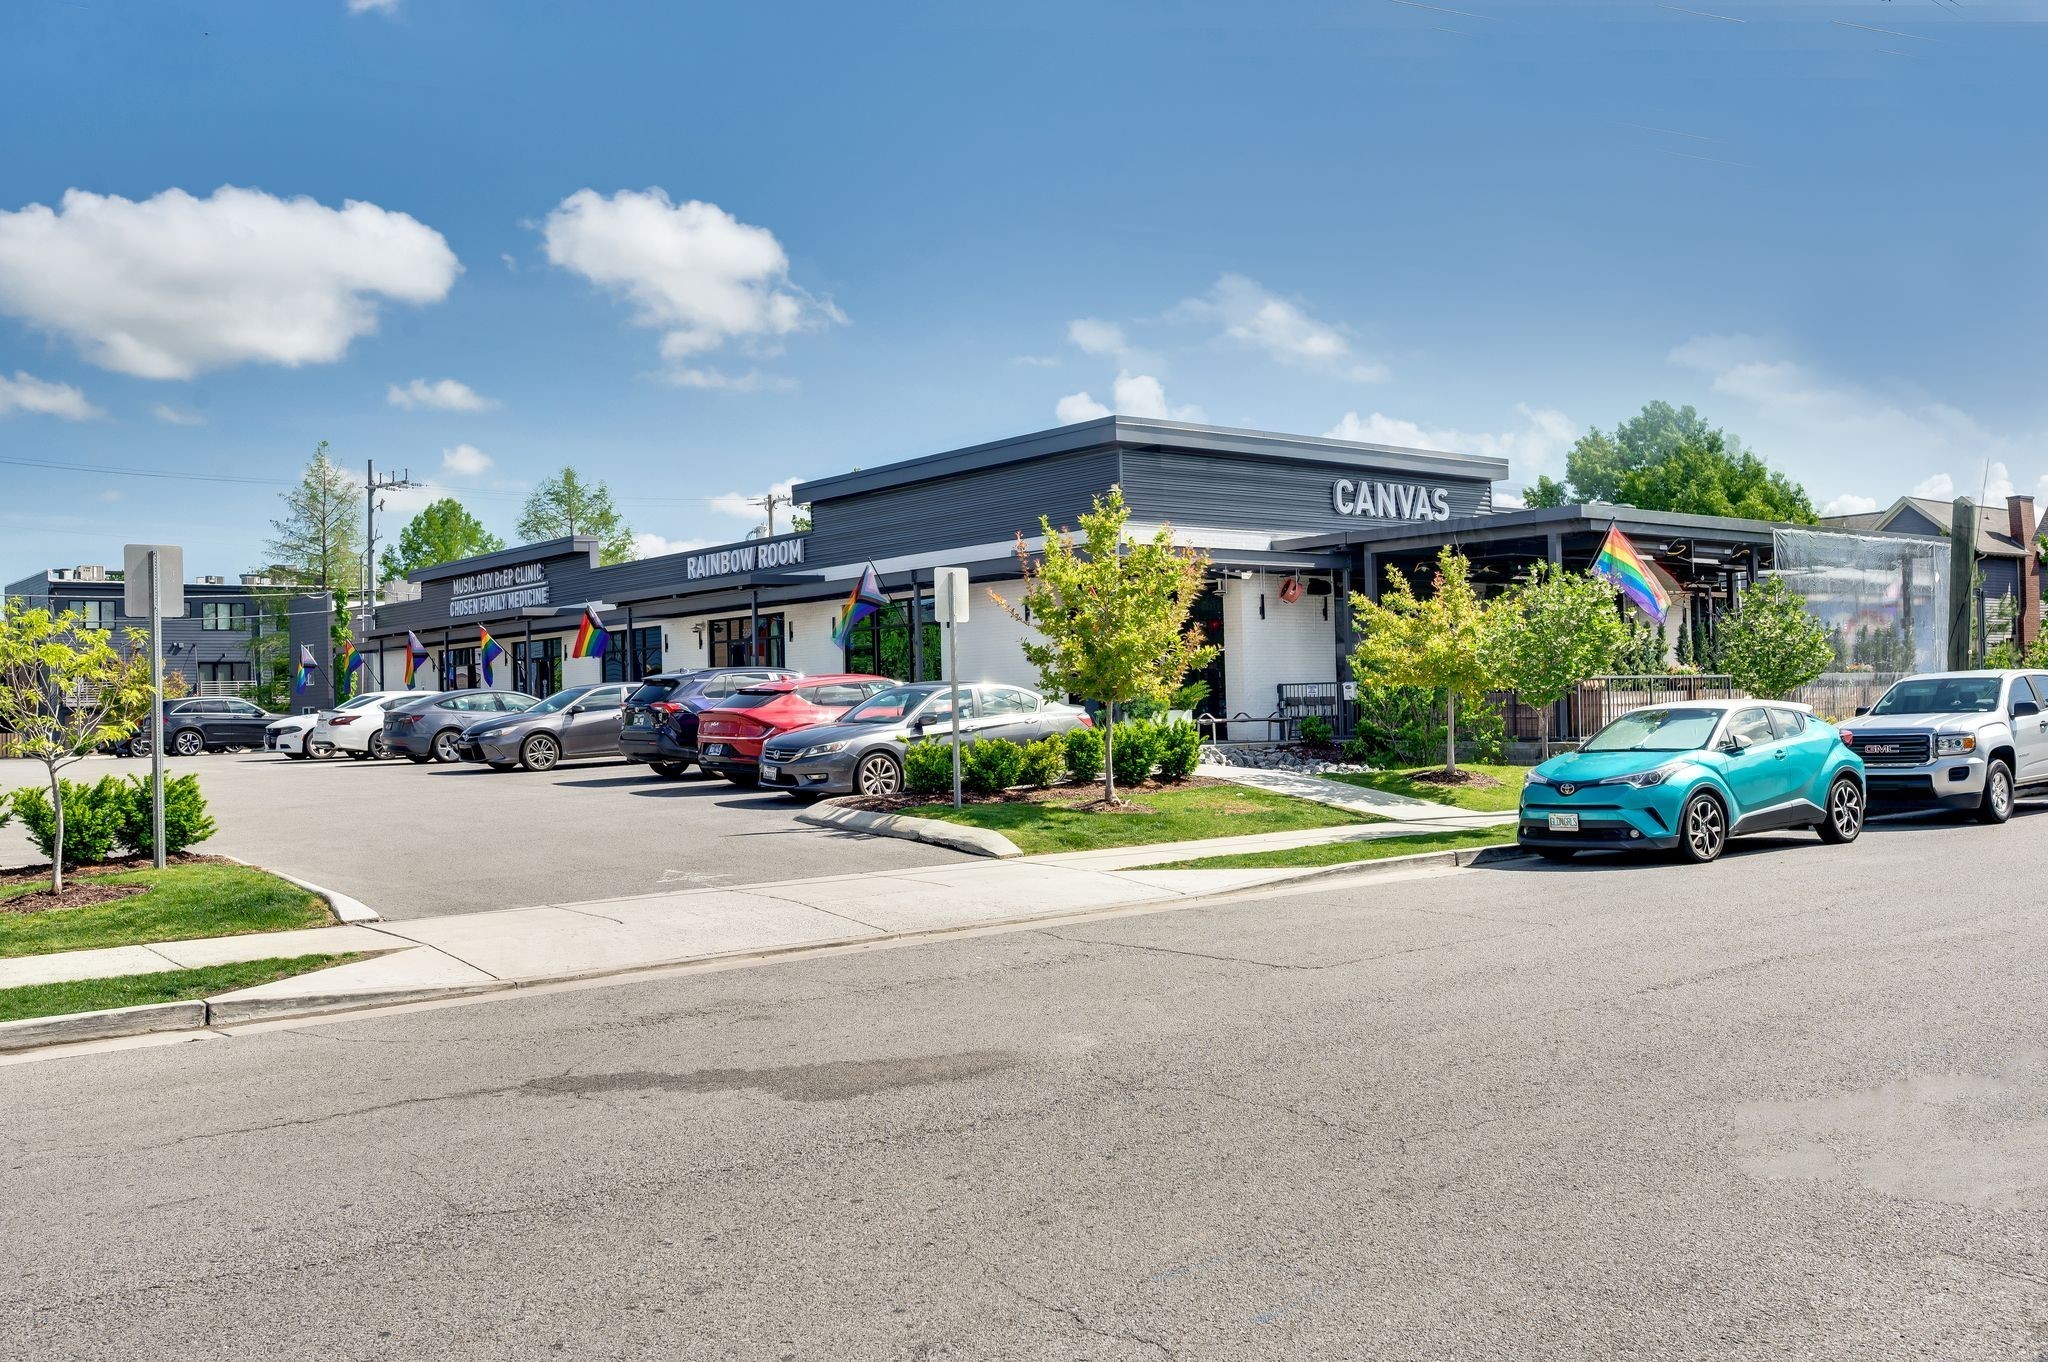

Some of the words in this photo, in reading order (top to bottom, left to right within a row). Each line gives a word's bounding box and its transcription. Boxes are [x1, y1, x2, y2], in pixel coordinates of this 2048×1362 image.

[1333, 479, 1450, 521] CANVAS
[687, 546, 756, 579] RAINBOW
[758, 538, 804, 569] ROOM
[453, 575, 477, 594] MUSIC
[477, 572, 495, 591] CITY
[494, 568, 513, 587] PrEP
[515, 563, 544, 584] CLINIC
[450, 601, 479, 617] CHOSEN
[480, 593, 507, 613] FAMILY
[508, 586, 549, 609] MEDICINE
[1865, 744, 1899, 753] GMC
